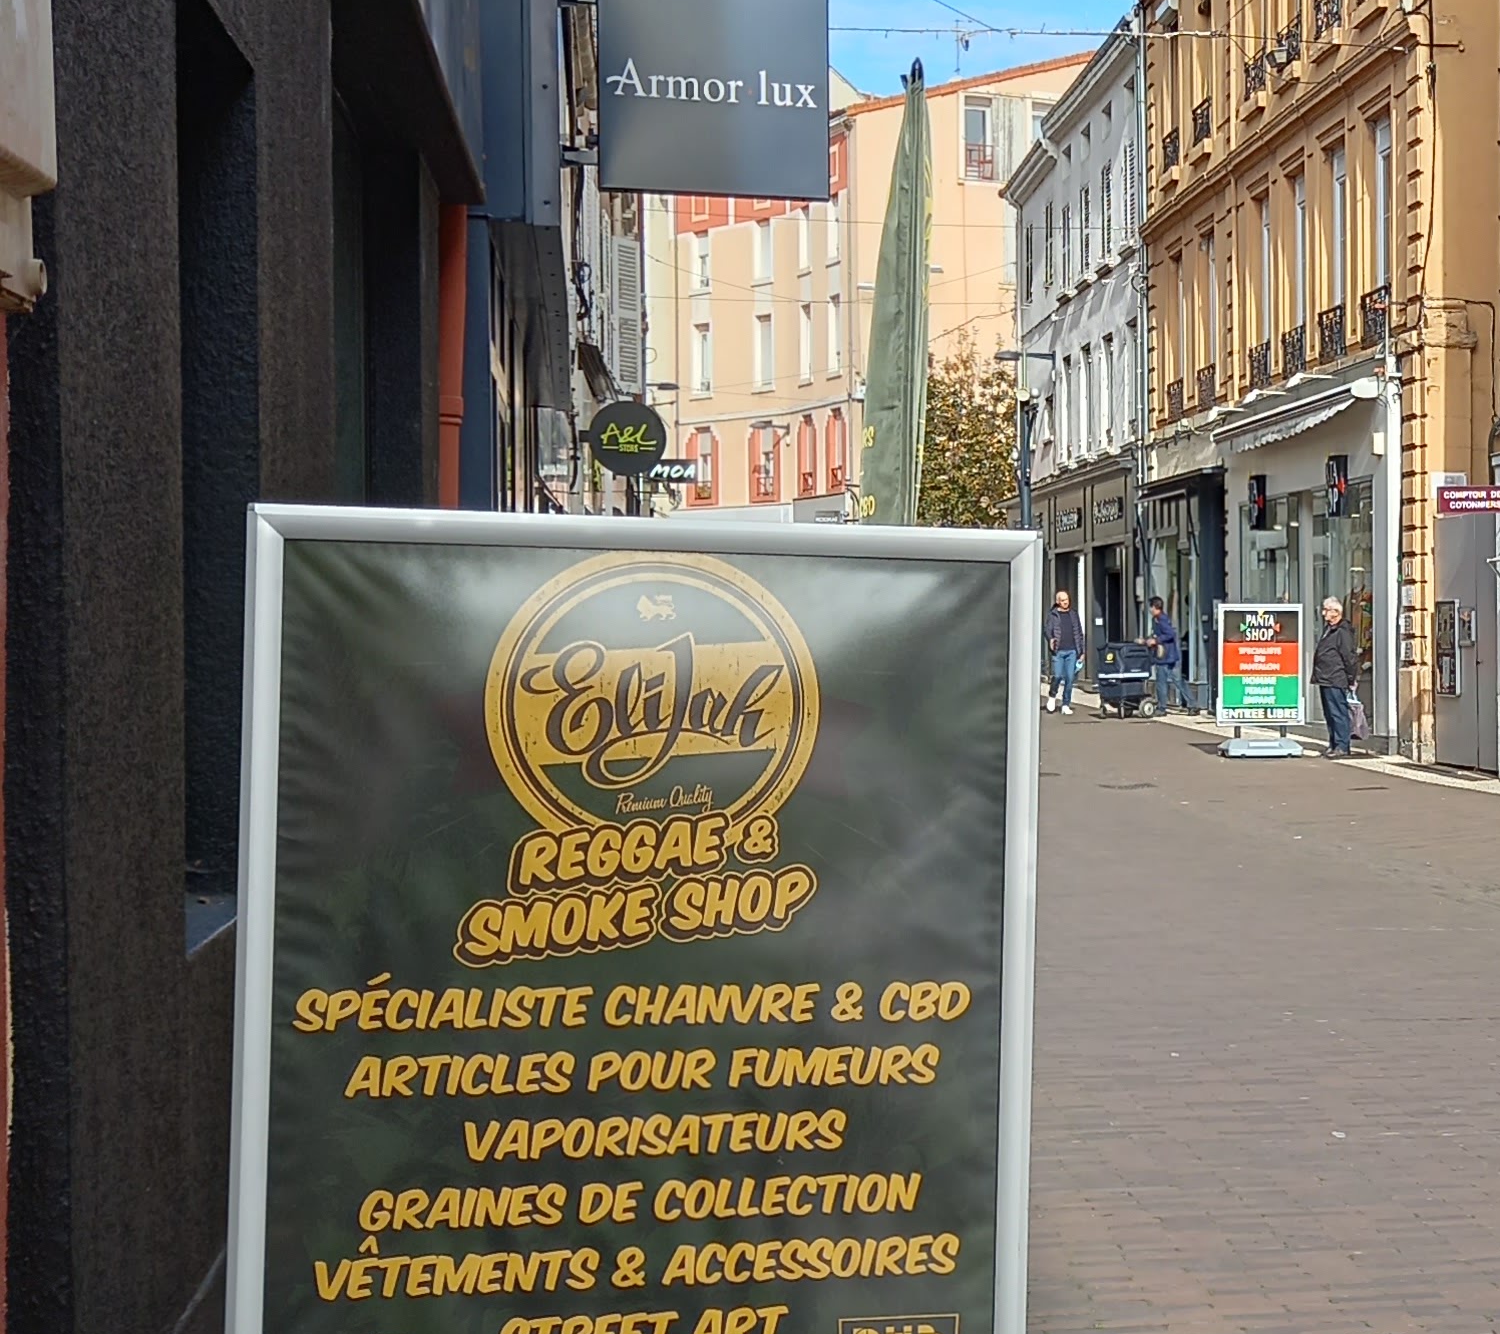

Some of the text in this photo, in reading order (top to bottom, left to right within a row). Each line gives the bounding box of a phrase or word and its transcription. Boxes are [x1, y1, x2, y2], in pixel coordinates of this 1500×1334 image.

[606, 57, 817, 108] Armor lux
[650, 464, 696, 479] MOA
[1443, 491, 1487, 500] COMPTOIR
[1245, 614, 1275, 627] PANTA
[1245, 628, 1274, 641] SHOP
[1222, 708, 1298, 719] ENTREE LIBRE
[615, 784, 714, 814] Premium Quality
[514, 816, 779, 887] REGGAE &
[461, 870, 812, 959] SMOKE SHOP
[293, 974, 971, 1032] SPÉCIALISTE CHANVRE & CBD
[345, 1044, 941, 1098] ARTICLES POUR FUMEURS
[464, 1109, 847, 1162] VAPORISATEURS
[359, 1173, 922, 1232] GRAINES DE COLLECTION
[314, 1234, 960, 1300] VÊTEMENTS & ACCESSOIRES
